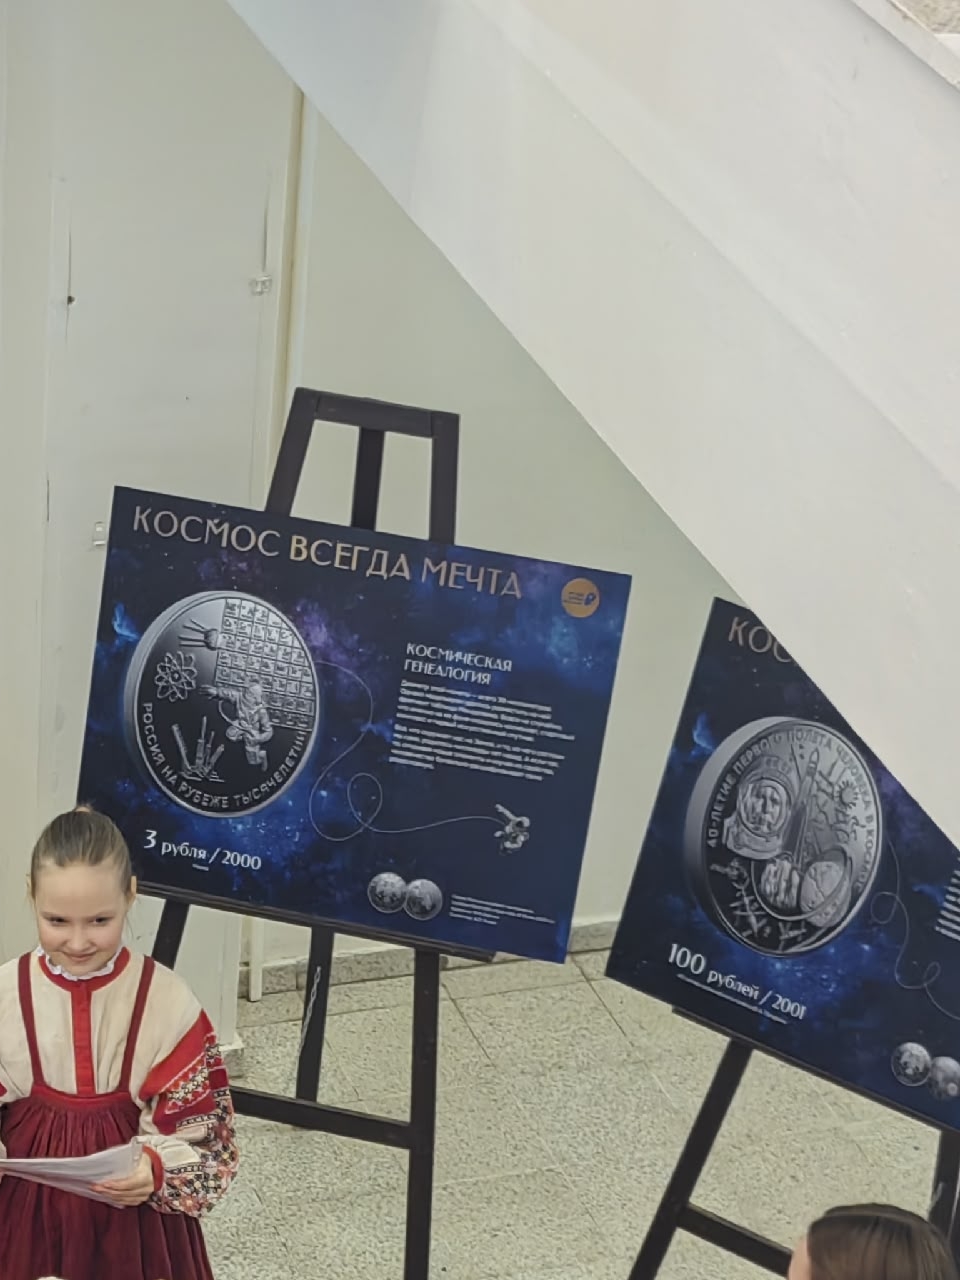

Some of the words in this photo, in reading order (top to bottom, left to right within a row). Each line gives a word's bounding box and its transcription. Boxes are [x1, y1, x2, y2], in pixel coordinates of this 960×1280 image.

[133, 505, 280, 556] КОСМОС
[289, 535, 411, 581] ВСЕГДА
[421, 557, 521, 599] МЕЧТА
[404, 659, 491, 685] ГЕНЕАЛОГИЯ
[406, 643, 512, 671] КОСМИЧЕСКАЯ
[143, 702, 166, 765] РОССИЯ
[161, 766, 179, 785] НА
[178, 782, 229, 808] РУБЕЖЕ
[143, 829, 157, 849] 3
[161, 841, 207, 860] рубля
[221, 850, 262, 870] 2000
[668, 943, 706, 975] 100
[706, 970, 760, 1000] рублей
[771, 993, 807, 1020] 2001
